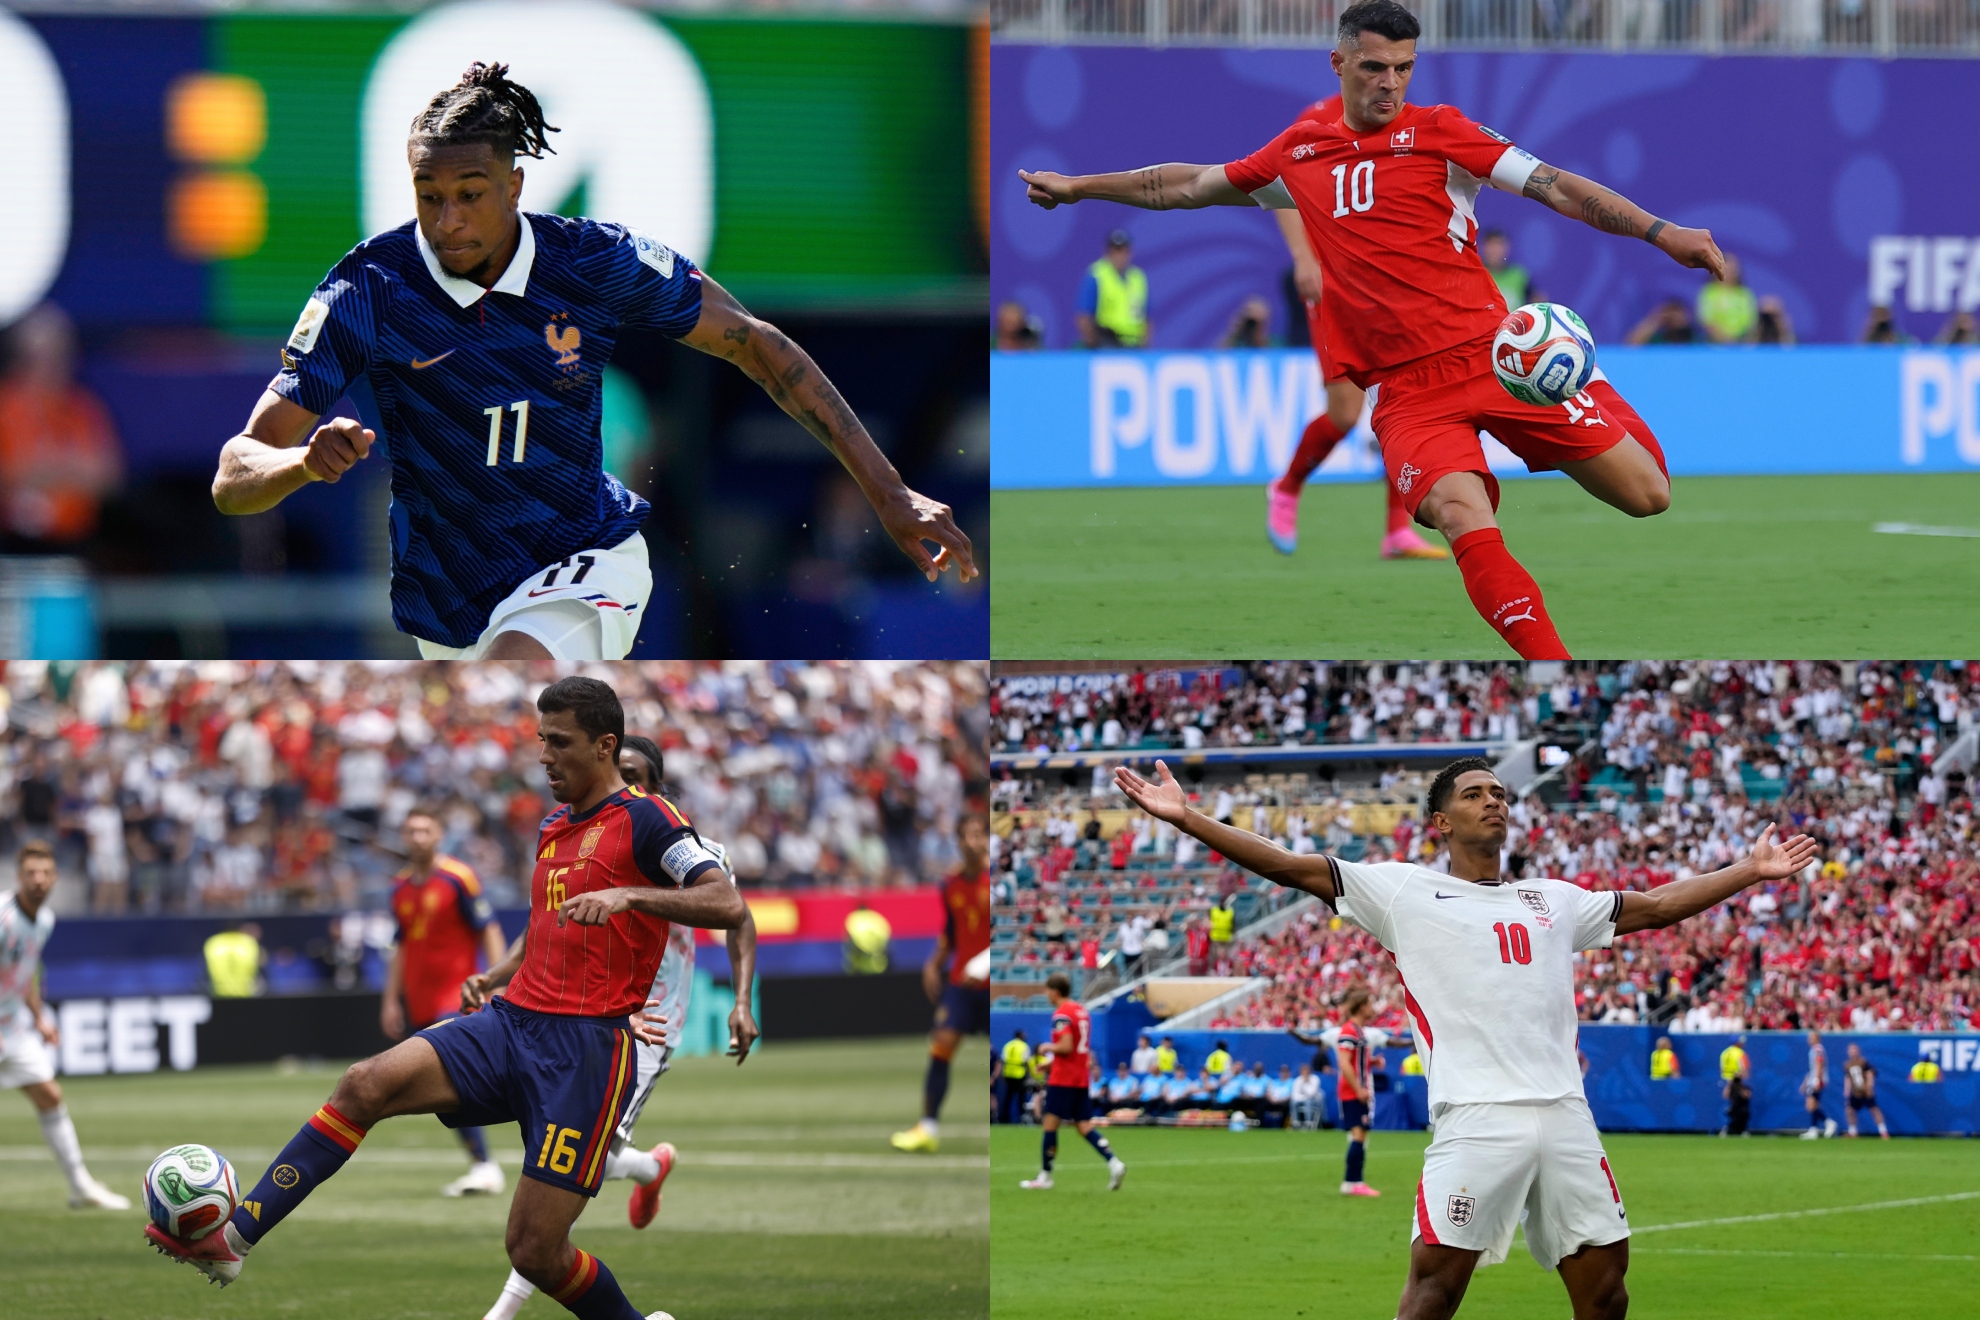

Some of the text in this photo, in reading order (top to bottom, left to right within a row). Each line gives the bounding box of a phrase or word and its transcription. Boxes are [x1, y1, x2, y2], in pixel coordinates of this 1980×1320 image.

[1331, 160, 1375, 218] 10
[484, 400, 529, 467] 11
[542, 555, 595, 587] 11
[663, 841, 688, 864] FOOTBALL
[667, 847, 692, 870] UNITES
[546, 867, 570, 912] 16
[1492, 921, 1532, 965] 10
[46, 995, 212, 1074] EET
[1918, 1039, 1980, 1072] FIF
[536, 1123, 582, 1175] 16
